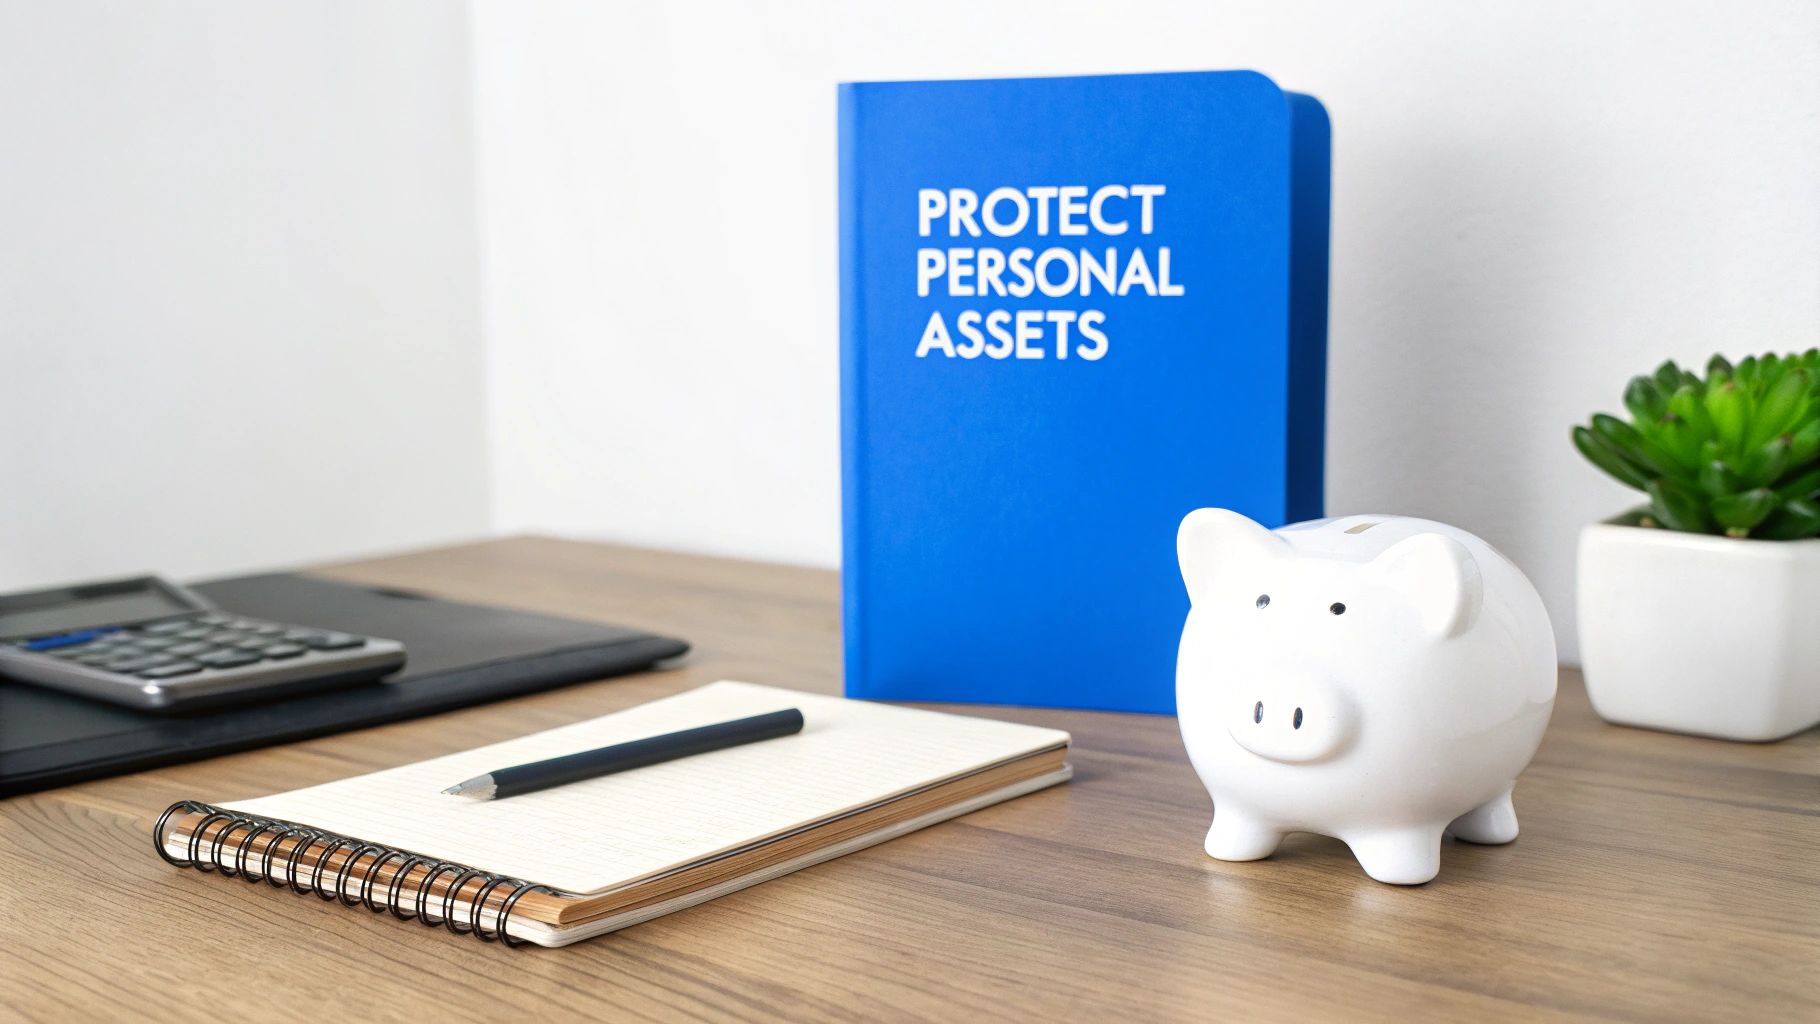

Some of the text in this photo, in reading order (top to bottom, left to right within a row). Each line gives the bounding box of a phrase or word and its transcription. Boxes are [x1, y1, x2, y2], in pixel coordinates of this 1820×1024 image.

[918, 184, 1166, 238] PROTECT
[917, 246, 1185, 298] PERSONAL
[915, 309, 1109, 361] ASSETS
